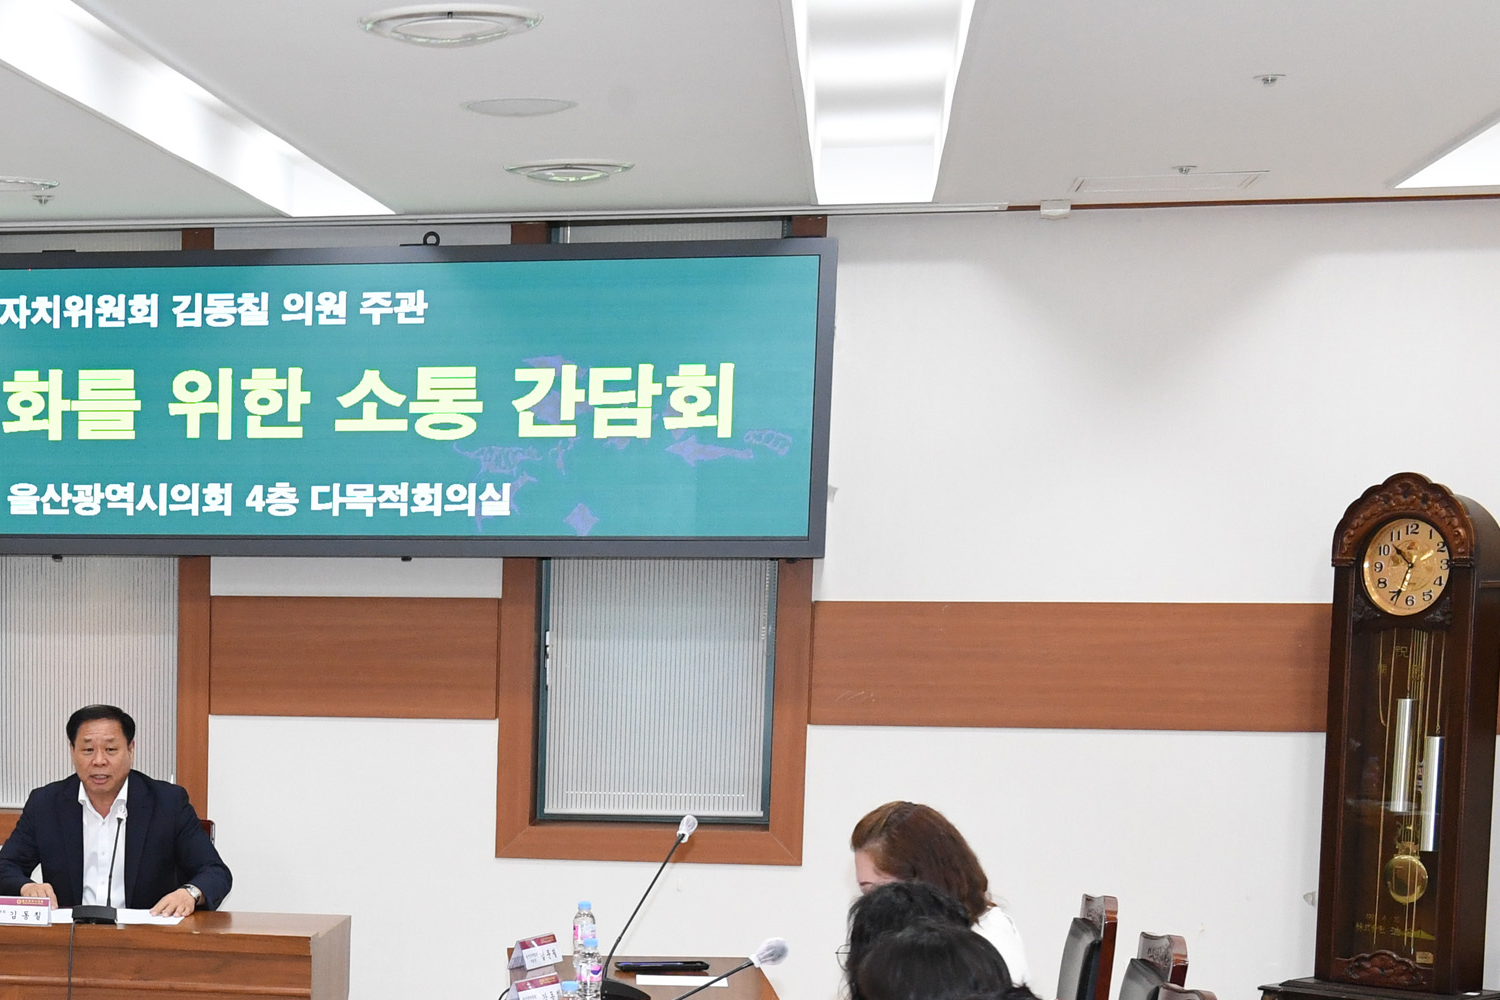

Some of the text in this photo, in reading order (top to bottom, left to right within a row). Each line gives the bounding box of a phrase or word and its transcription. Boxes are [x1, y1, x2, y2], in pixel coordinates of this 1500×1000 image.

[171, 291, 269, 328] 김동칠
[281, 290, 348, 326] 의원
[359, 289, 429, 326] 주관
[168, 367, 311, 441] 위한
[334, 366, 484, 441] 소통
[511, 362, 735, 439] 간담회
[7, 482, 512, 517] 울산광역시의회 4층 다목적회의실
[1405, 523, 1419, 535] 12
[1390, 529, 1402, 542] 11
[1378, 544, 1390, 556] 10
[1437, 542, 1447, 553] 2
[1374, 562, 1383, 573] 9
[1440, 559, 1449, 570] 3
[1377, 578, 1387, 589] 8
[1433, 576, 1444, 587] 4
[1389, 590, 1401, 602] 7
[1405, 595, 1415, 606] 6
[1422, 590, 1433, 602] 5
